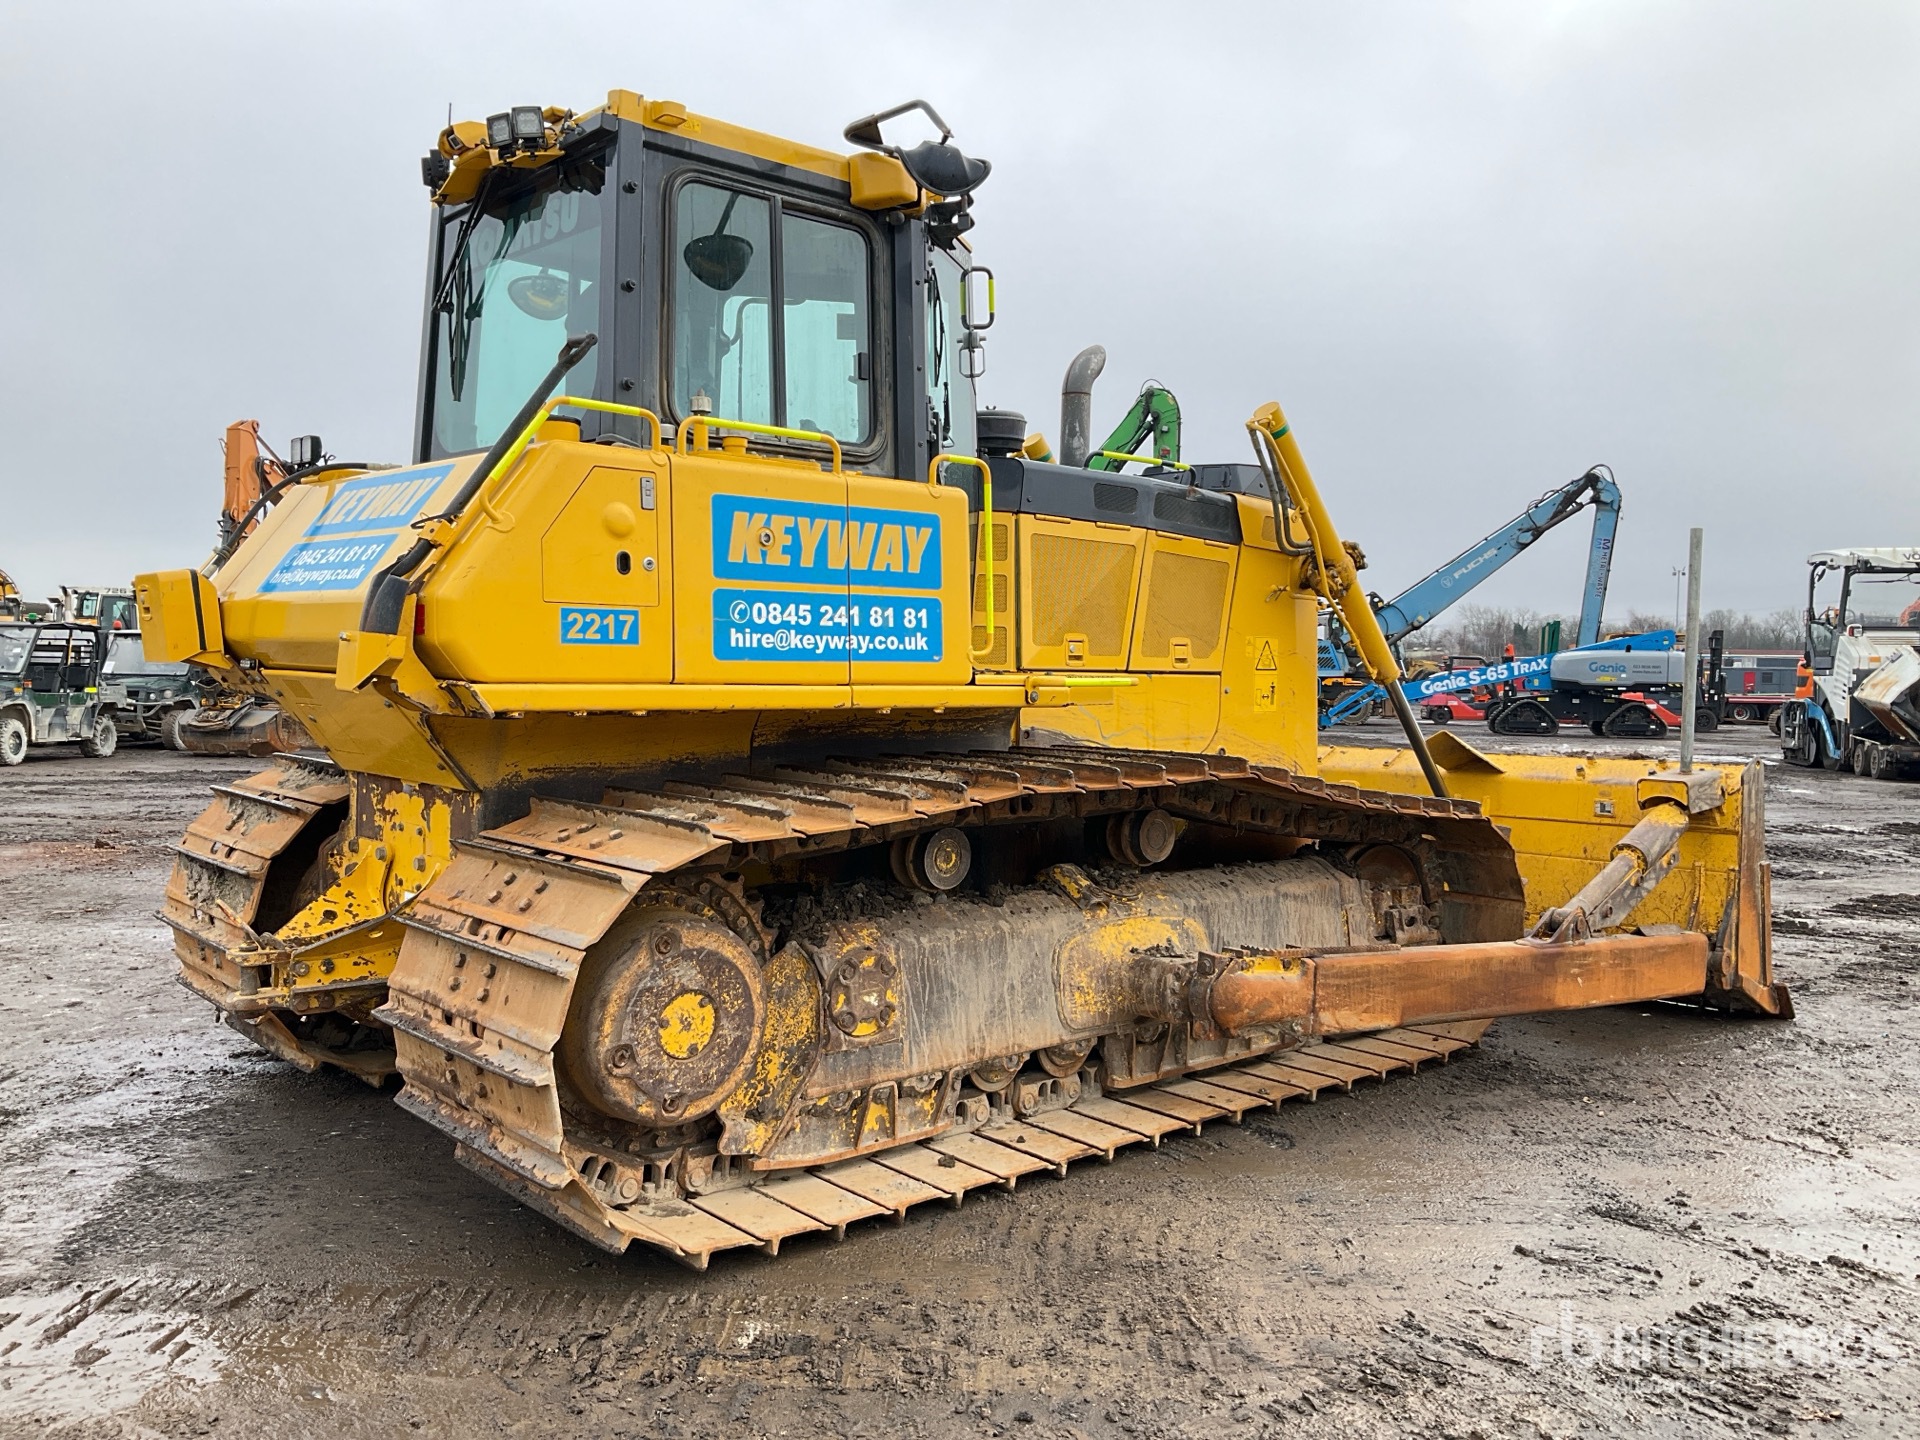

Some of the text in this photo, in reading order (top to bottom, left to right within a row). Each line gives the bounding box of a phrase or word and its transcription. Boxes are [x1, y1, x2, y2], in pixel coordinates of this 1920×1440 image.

[315, 476, 442, 527] KEYWAY
[292, 543, 385, 567] 0845 241 81 81
[727, 510, 933, 574] KEYWAY
[268, 564, 366, 586] hire@keyway.co.uk
[1453, 547, 1497, 579] FUCHS
[567, 612, 635, 640] 2217
[752, 602, 928, 629] 0845 241 81 81
[730, 628, 928, 654] hire@keyway.co.uk
[1420, 675, 1466, 694] Genie
[1468, 664, 1508, 685] S-65
[1588, 661, 1627, 673] Genie
